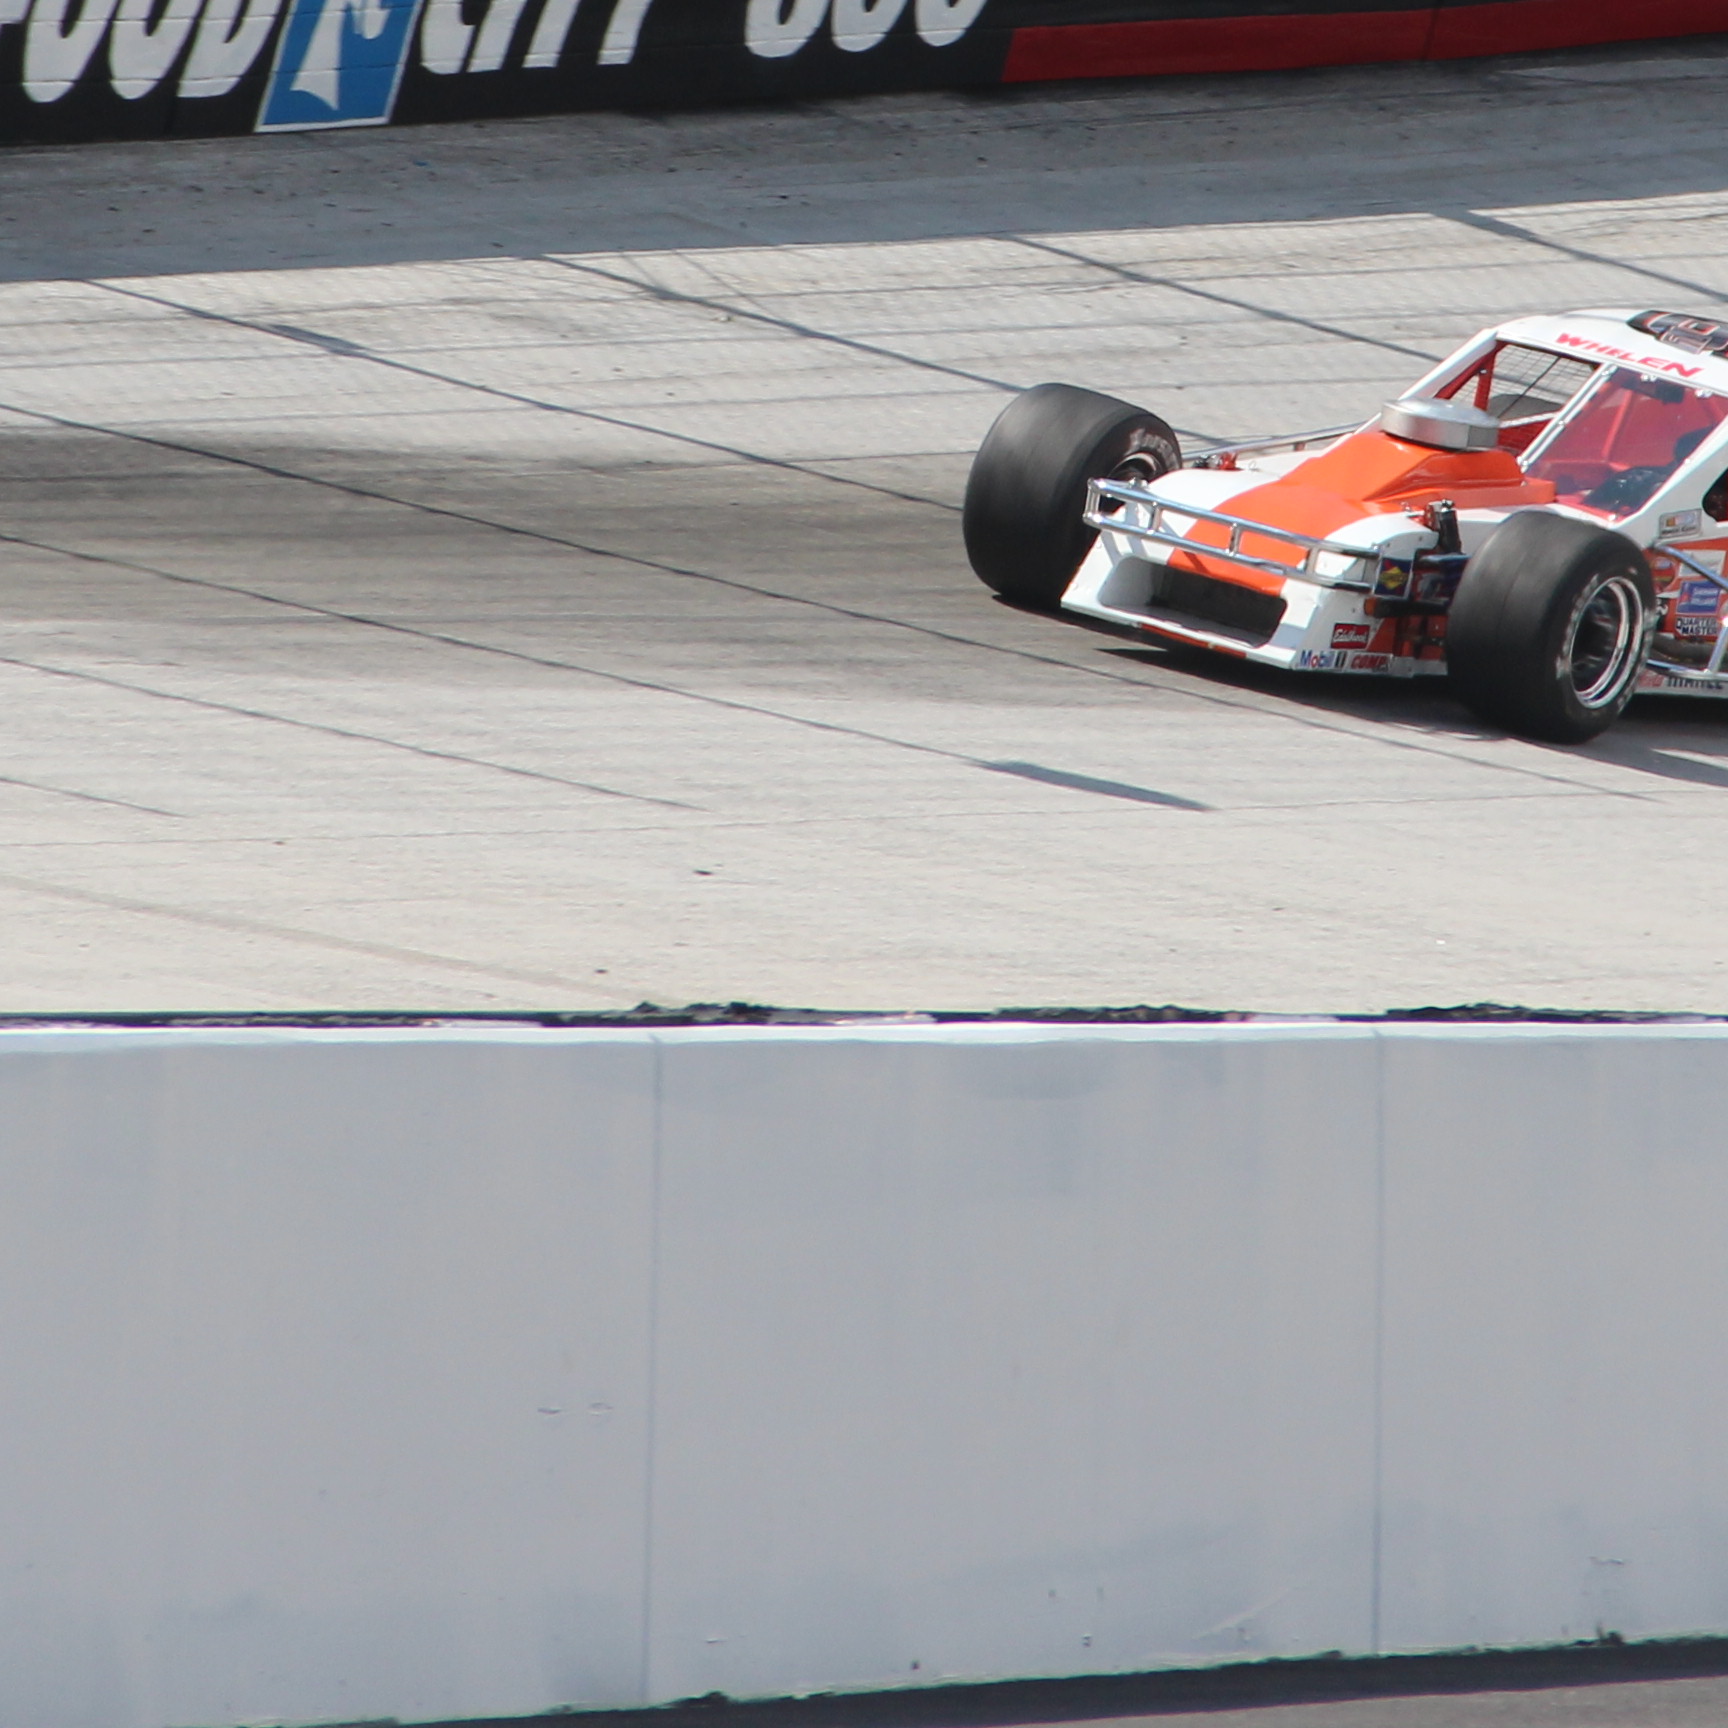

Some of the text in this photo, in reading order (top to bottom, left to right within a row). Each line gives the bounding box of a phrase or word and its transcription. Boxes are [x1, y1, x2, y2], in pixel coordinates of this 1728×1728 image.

[1555, 332, 1705, 378] WHELEN
[1677, 617, 1719, 630] QUARTER
[1682, 626, 1718, 637] MASTER
[1300, 649, 1333, 669] Mobil
